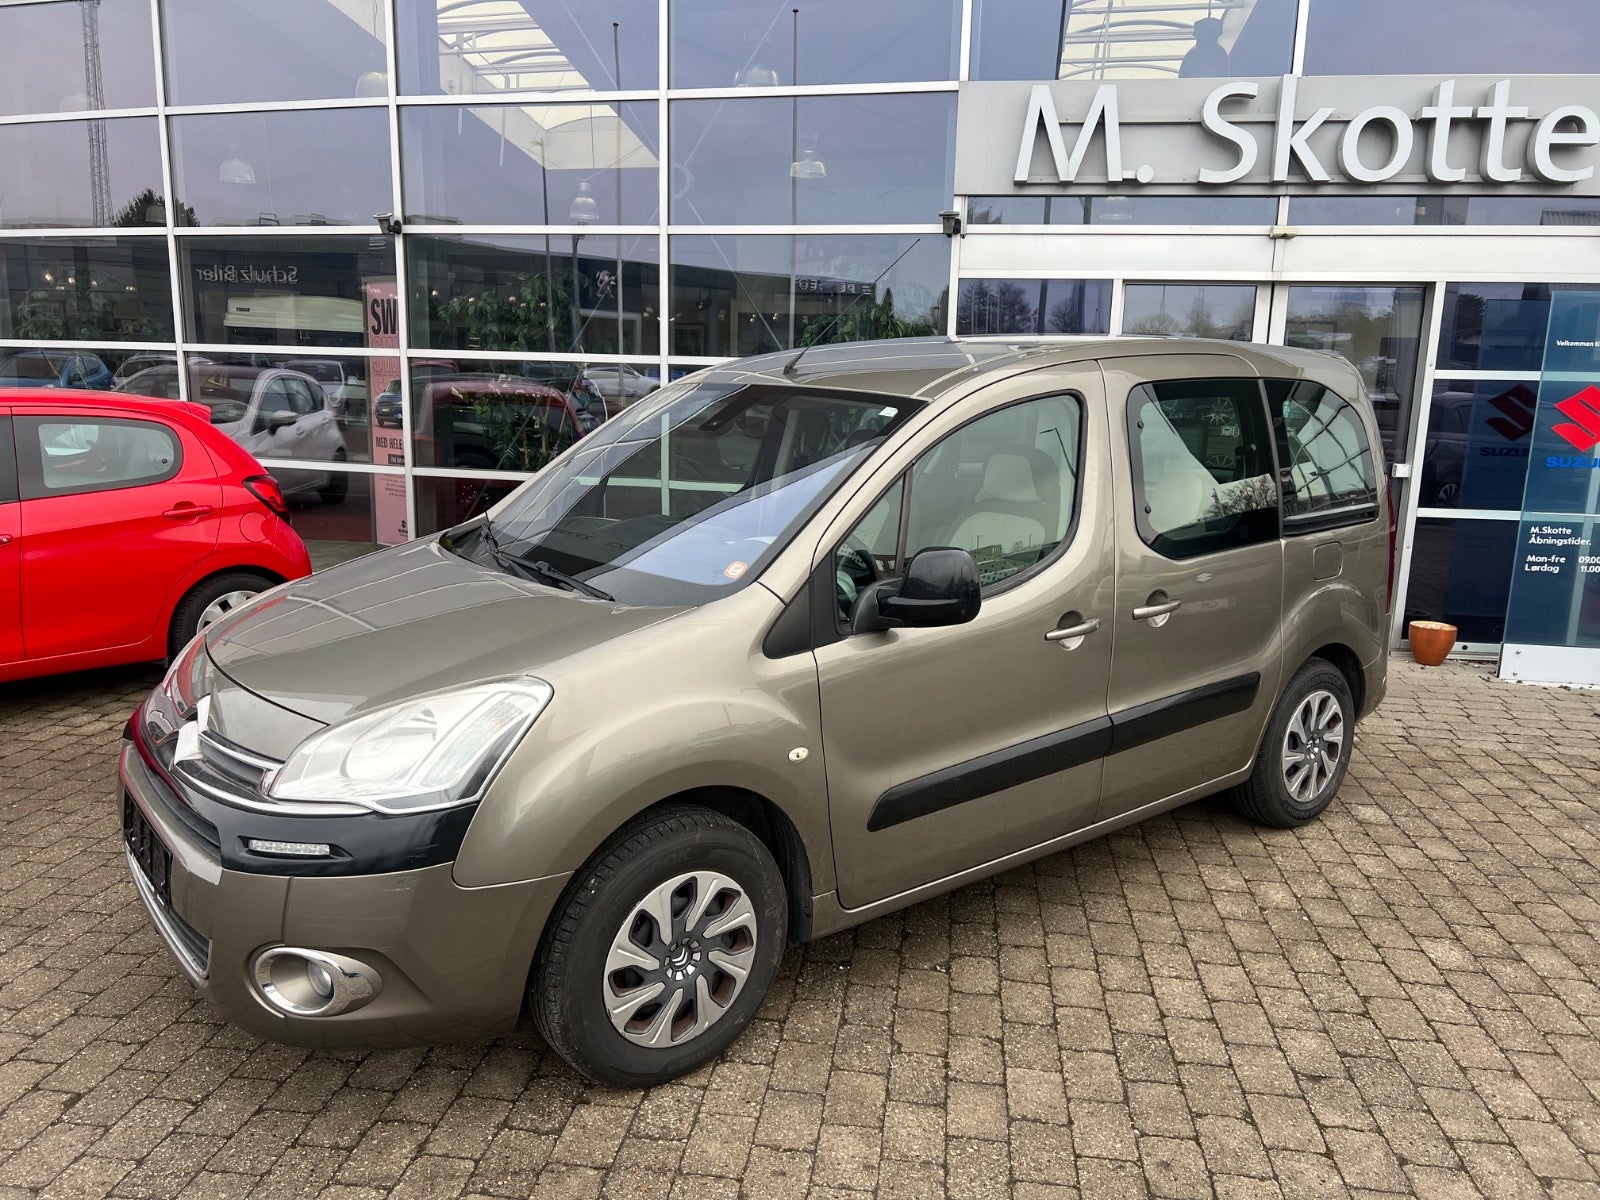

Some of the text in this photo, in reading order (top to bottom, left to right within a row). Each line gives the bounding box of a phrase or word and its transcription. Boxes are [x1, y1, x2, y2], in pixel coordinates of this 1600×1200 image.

[1014, 74, 1600, 184] M. Skotte
[371, 298, 399, 335] SW
[1545, 456, 1600, 468] SUZU
[1530, 526, 1572, 534] M.Skotte
[1528, 534, 1592, 546] Åbningstider.
[1526, 555, 1566, 563] Man-fre
[1524, 563, 1560, 574] Lørdag
